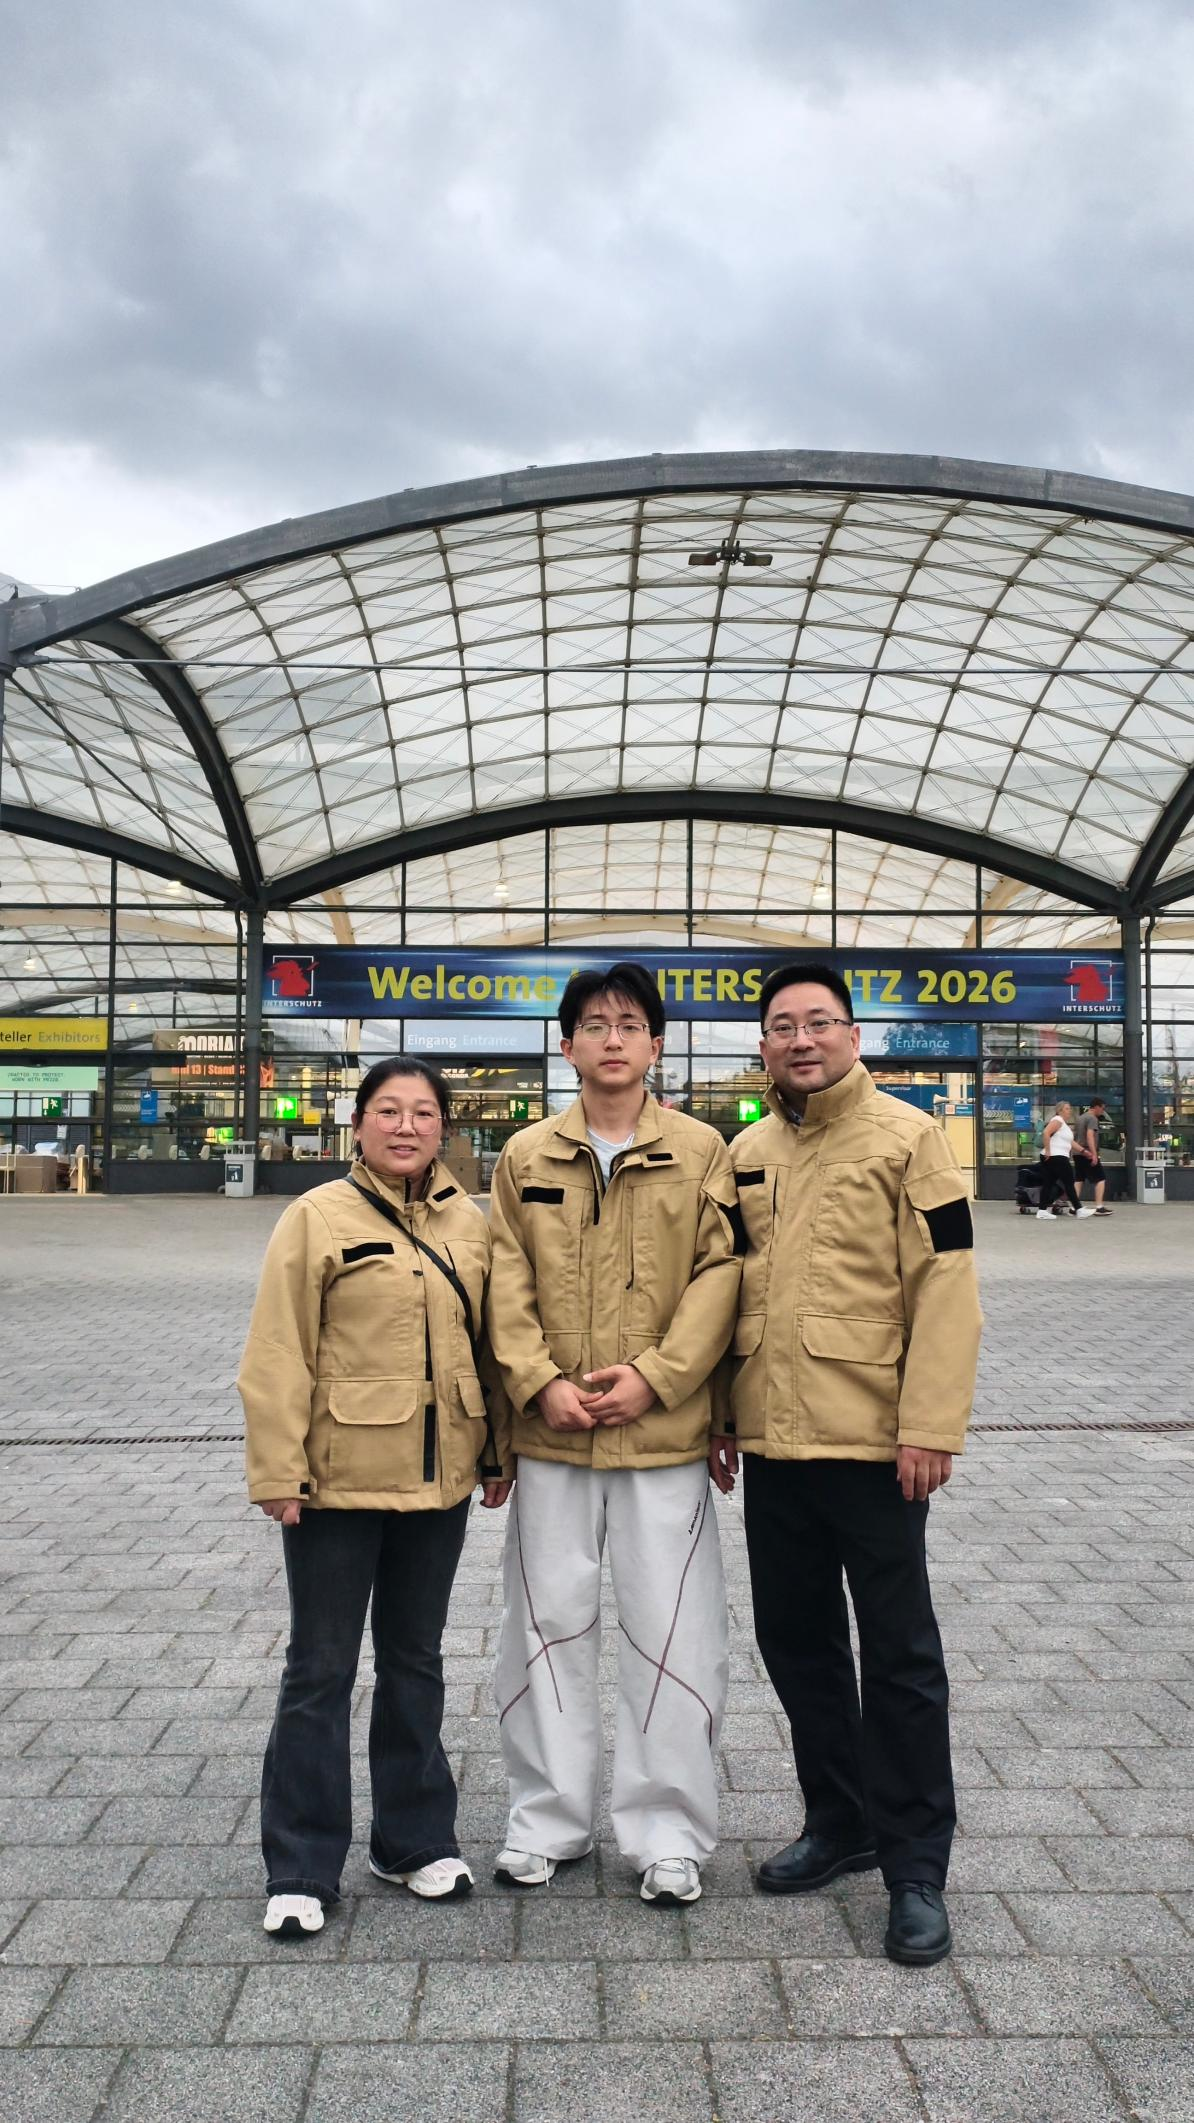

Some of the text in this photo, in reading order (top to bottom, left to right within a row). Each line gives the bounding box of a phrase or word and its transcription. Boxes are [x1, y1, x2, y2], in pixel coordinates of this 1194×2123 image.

[368, 964, 1017, 1004] Welcome TERSTZ 2026
[38, 1031, 101, 1042] Exhibitors
[407, 1034, 518, 1048] Eingang Entrance
[859, 1037, 950, 1051] gang Entrance
